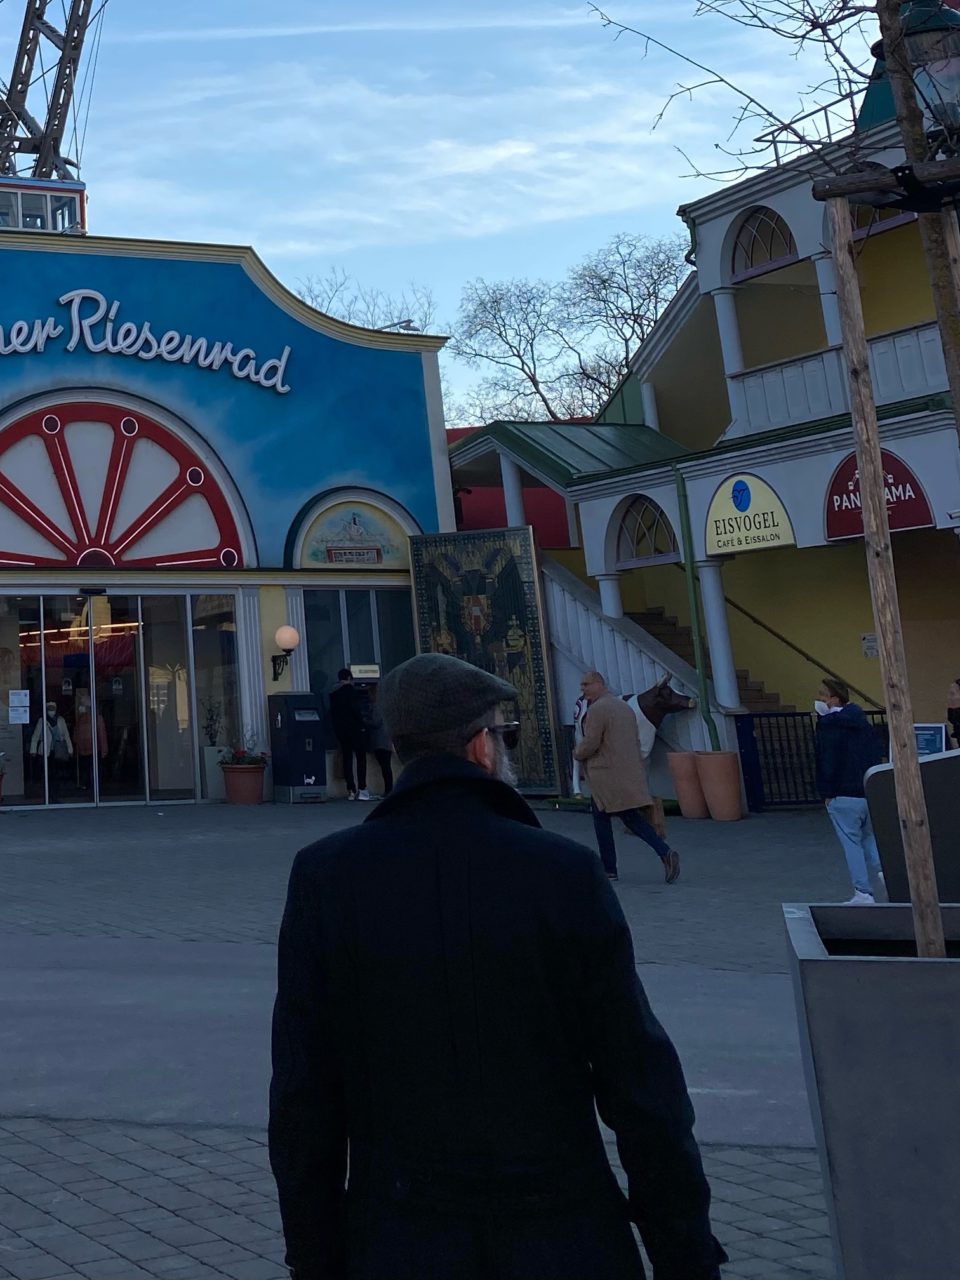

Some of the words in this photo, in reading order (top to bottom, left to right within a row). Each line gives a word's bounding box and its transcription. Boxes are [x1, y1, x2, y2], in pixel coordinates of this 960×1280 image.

[58, 288, 292, 394] Riesenrad
[833, 483, 916, 511] PANAMA
[713, 511, 780, 536] EISVOGEL
[737, 537, 743, 546] &
